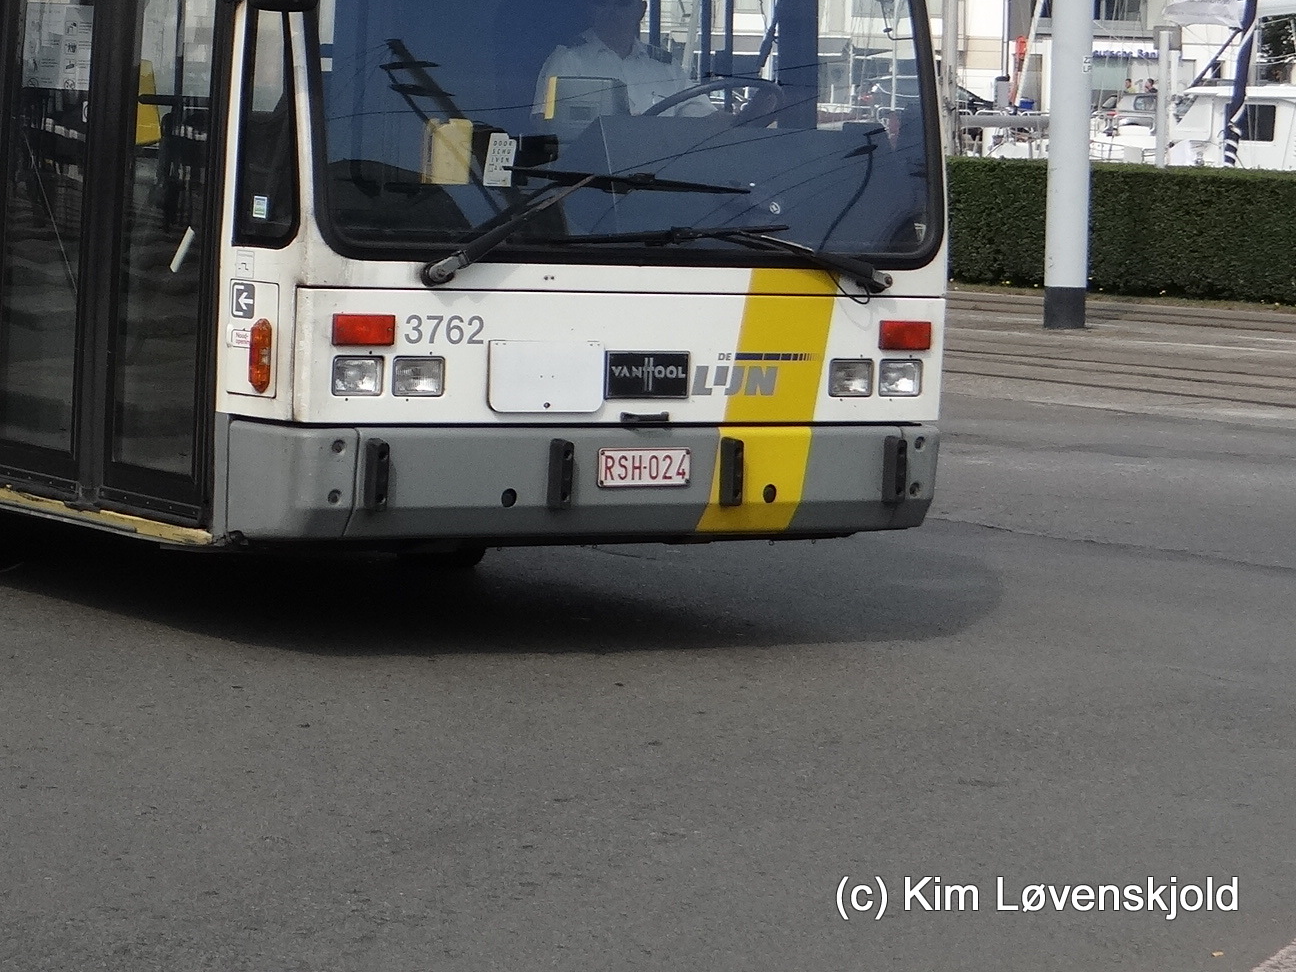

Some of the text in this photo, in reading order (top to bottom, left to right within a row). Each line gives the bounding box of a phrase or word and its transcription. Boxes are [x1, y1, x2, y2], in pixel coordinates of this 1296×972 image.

[404, 314, 485, 345] 3762
[717, 352, 732, 361] DE
[691, 365, 779, 396] LIJN
[604, 454, 686, 481] RSH-024
